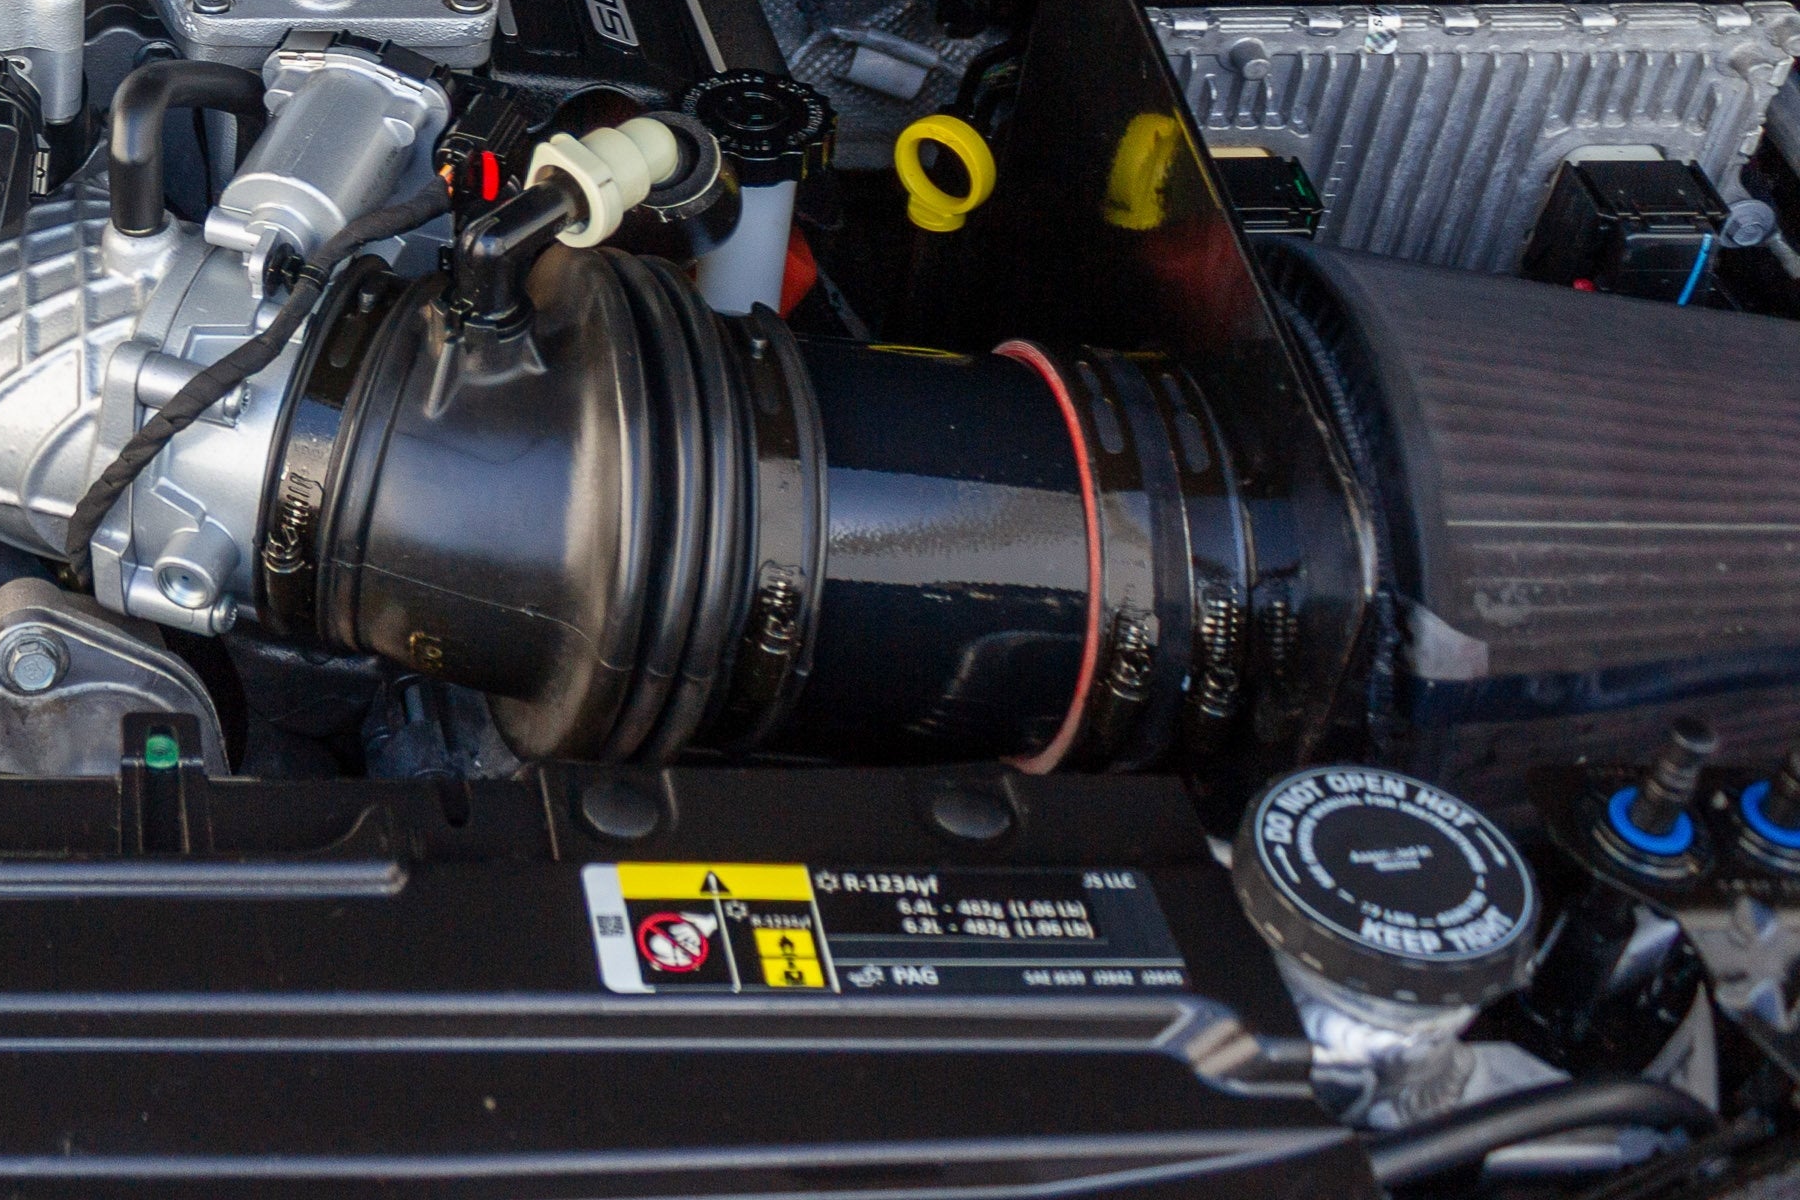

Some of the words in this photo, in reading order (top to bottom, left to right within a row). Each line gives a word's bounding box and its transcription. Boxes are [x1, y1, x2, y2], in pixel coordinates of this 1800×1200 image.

[1274, 778, 1325, 815] NOT
[1325, 773, 1407, 799] OPEN
[1415, 788, 1478, 827] HOT
[1264, 811, 1294, 844] DO
[842, 873, 939, 897] R-1234yf
[897, 898, 939, 916] 6.4L
[902, 917, 944, 934] 6.2L
[1360, 916, 1442, 952] KEEP
[1442, 904, 1515, 952] TIGHT
[891, 965, 940, 986] PAG
